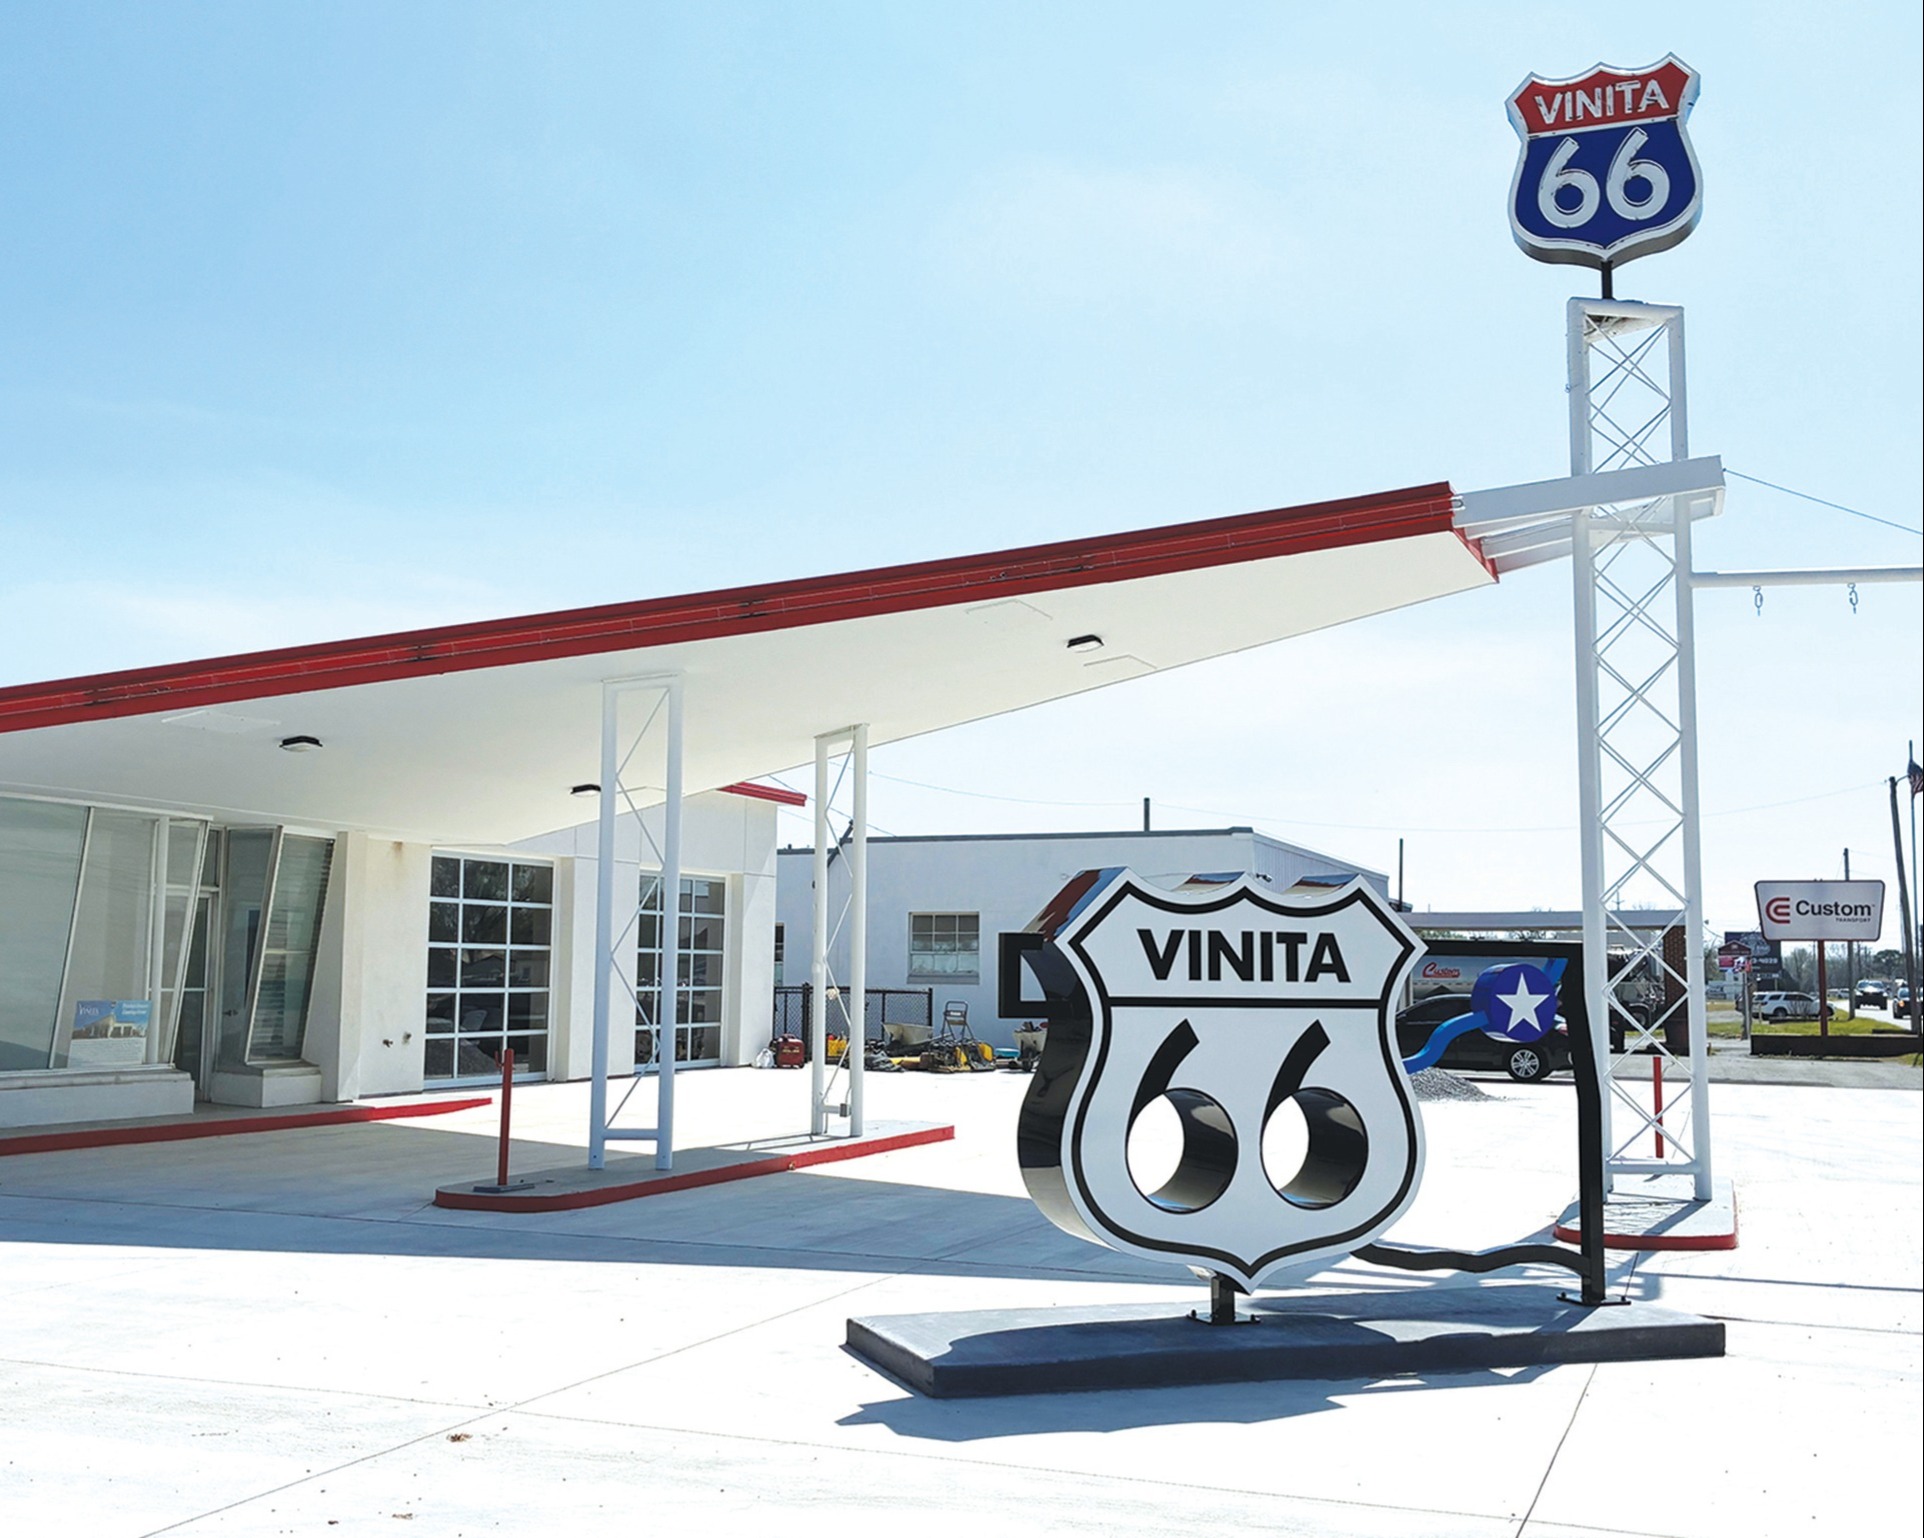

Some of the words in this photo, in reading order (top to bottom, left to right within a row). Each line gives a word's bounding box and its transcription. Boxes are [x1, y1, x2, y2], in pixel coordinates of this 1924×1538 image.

[1534, 79, 1670, 125] VINITA
[1538, 127, 1670, 229] 66
[1796, 900, 1871, 917] Custom
[1136, 928, 1352, 983] VINITA
[1125, 1018, 1369, 1214] 66
